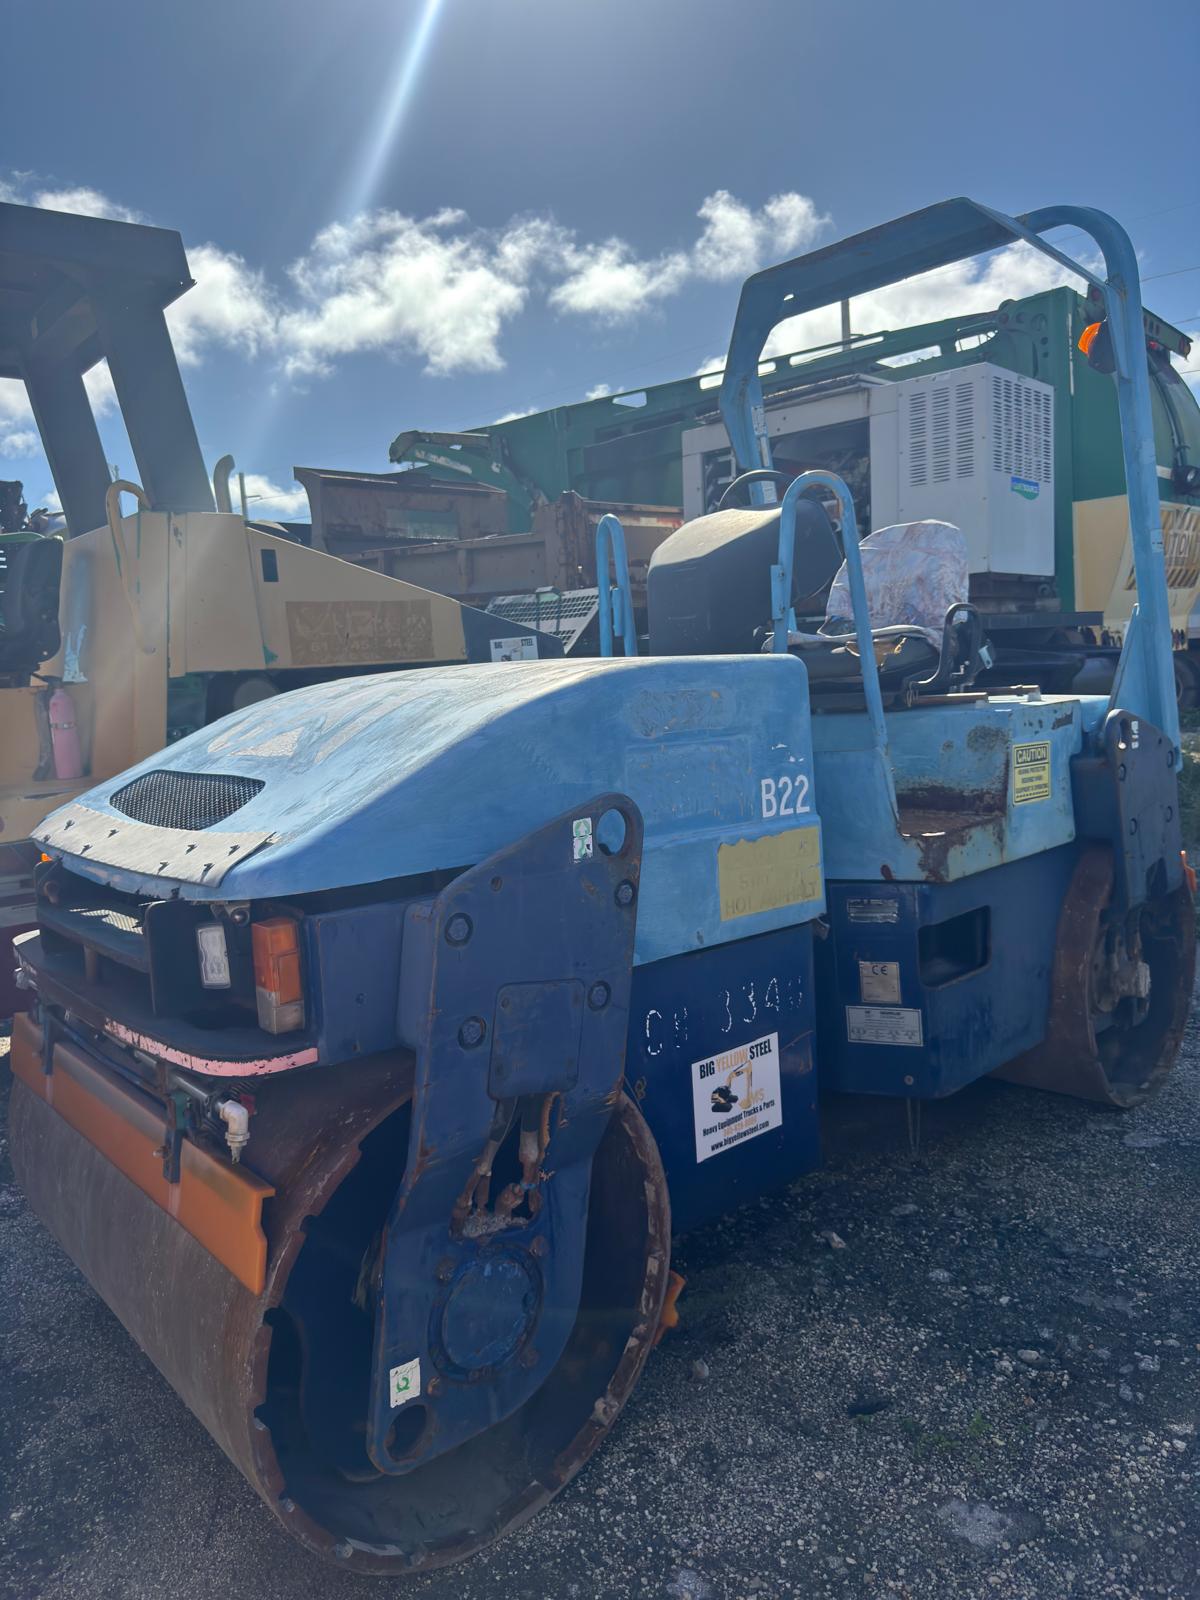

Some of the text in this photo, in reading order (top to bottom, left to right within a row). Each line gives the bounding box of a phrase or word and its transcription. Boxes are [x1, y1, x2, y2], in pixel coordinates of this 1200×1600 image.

[1017, 748, 1047, 762] CAUTION
[760, 774, 811, 818] B22
[871, 964, 889, 976] CE
[700, 1039, 772, 1079] BIG YELLOW STEEL
[702, 1124, 718, 1136] Heavy
[743, 1105, 759, 1118] Trucks
[763, 1099, 775, 1110] Parts
[711, 1120, 770, 1151] www.bigyellowsteel.com
